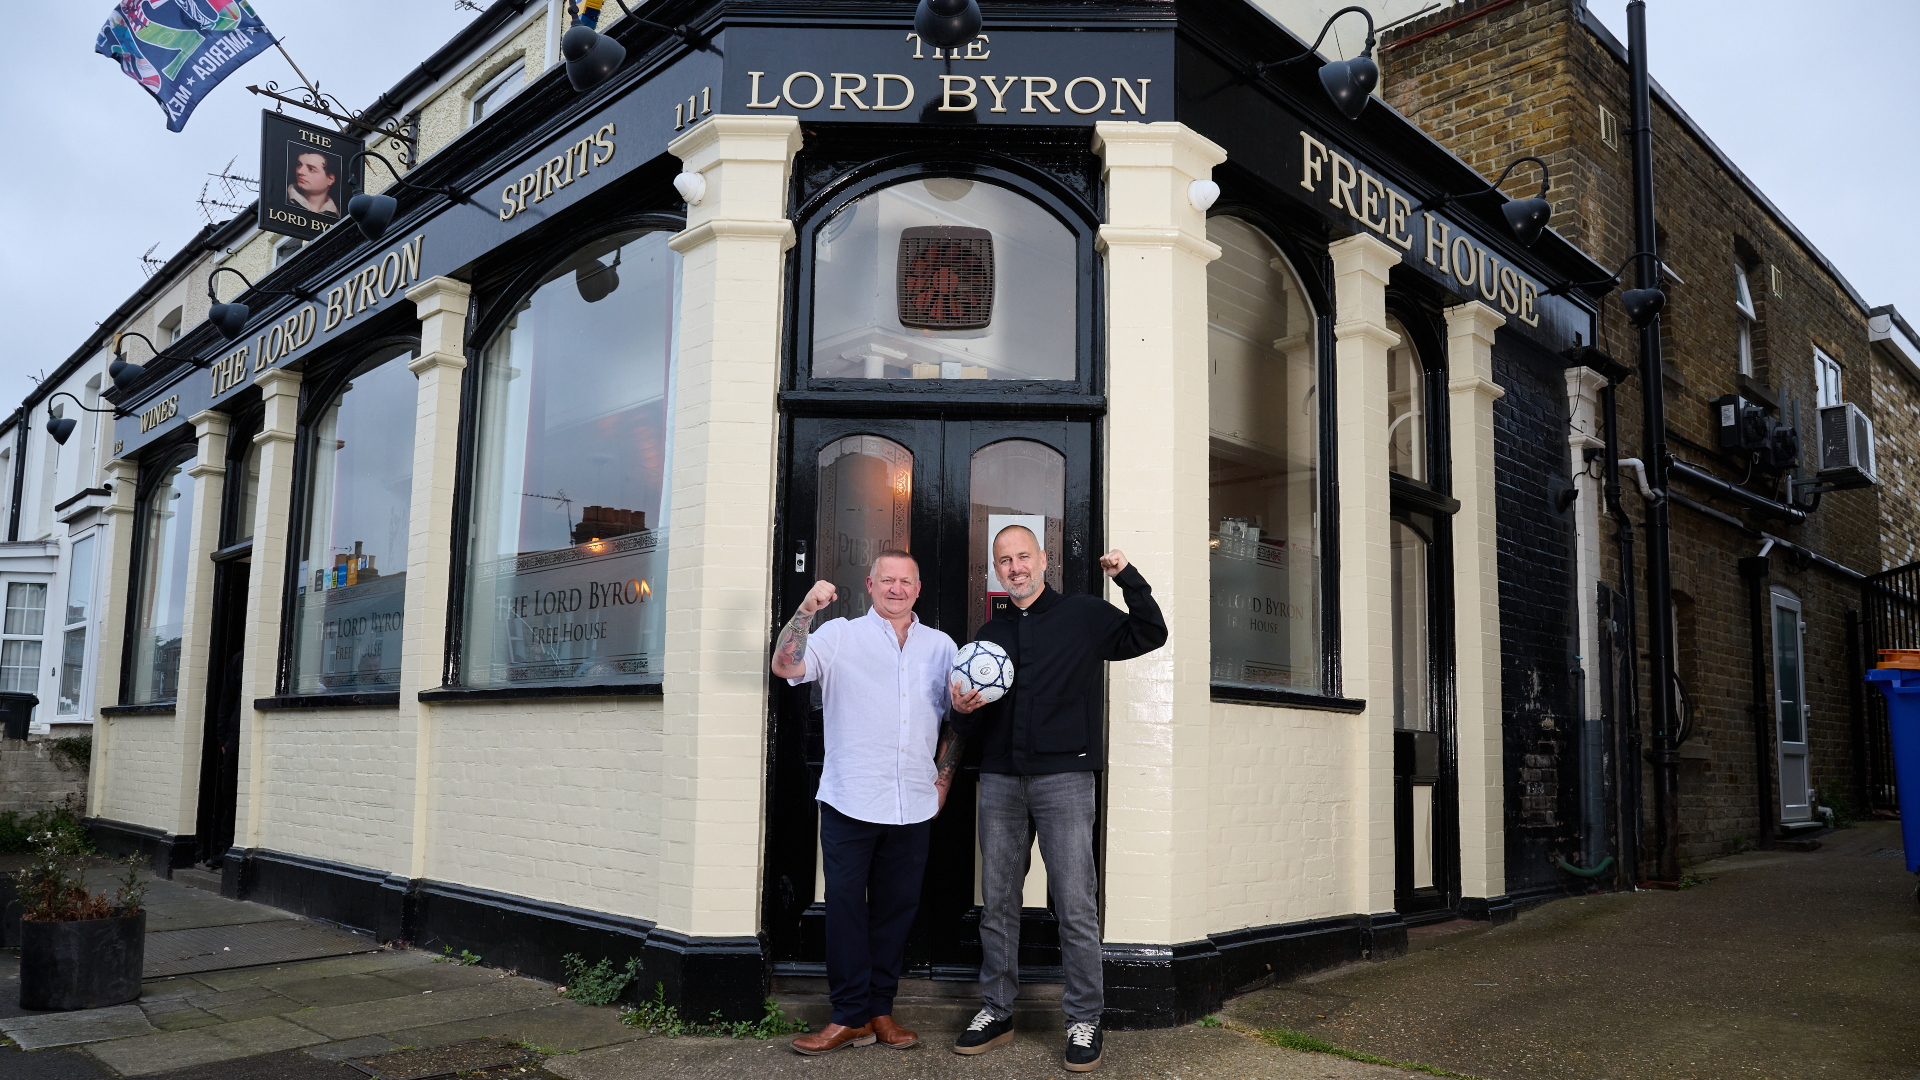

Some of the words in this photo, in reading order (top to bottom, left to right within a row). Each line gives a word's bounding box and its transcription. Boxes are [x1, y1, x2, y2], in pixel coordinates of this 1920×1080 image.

[674, 86, 712, 131] 111
[747, 71, 915, 111] LORD
[938, 74, 1151, 115] BYRON
[299, 129, 332, 148] THE
[500, 122, 616, 222] SPIRITS
[268, 208, 307, 227] LORD
[1300, 130, 1413, 250] FREE
[1423, 212, 1539, 328] HOUSE
[210, 345, 250, 399] THE
[253, 305, 317, 374] LORD
[323, 234, 425, 332] BYRON
[140, 394, 179, 434] WINES
[497, 595, 528, 621] THE
[534, 588, 582, 617] LORD
[588, 577, 655, 610] BYRON
[1266, 597, 1304, 620] BYRON
[338, 616, 367, 638] LORD
[531, 627, 559, 645] FREE
[563, 622, 607, 642] HOUSE
[1250, 617, 1279, 634] HOUSE
